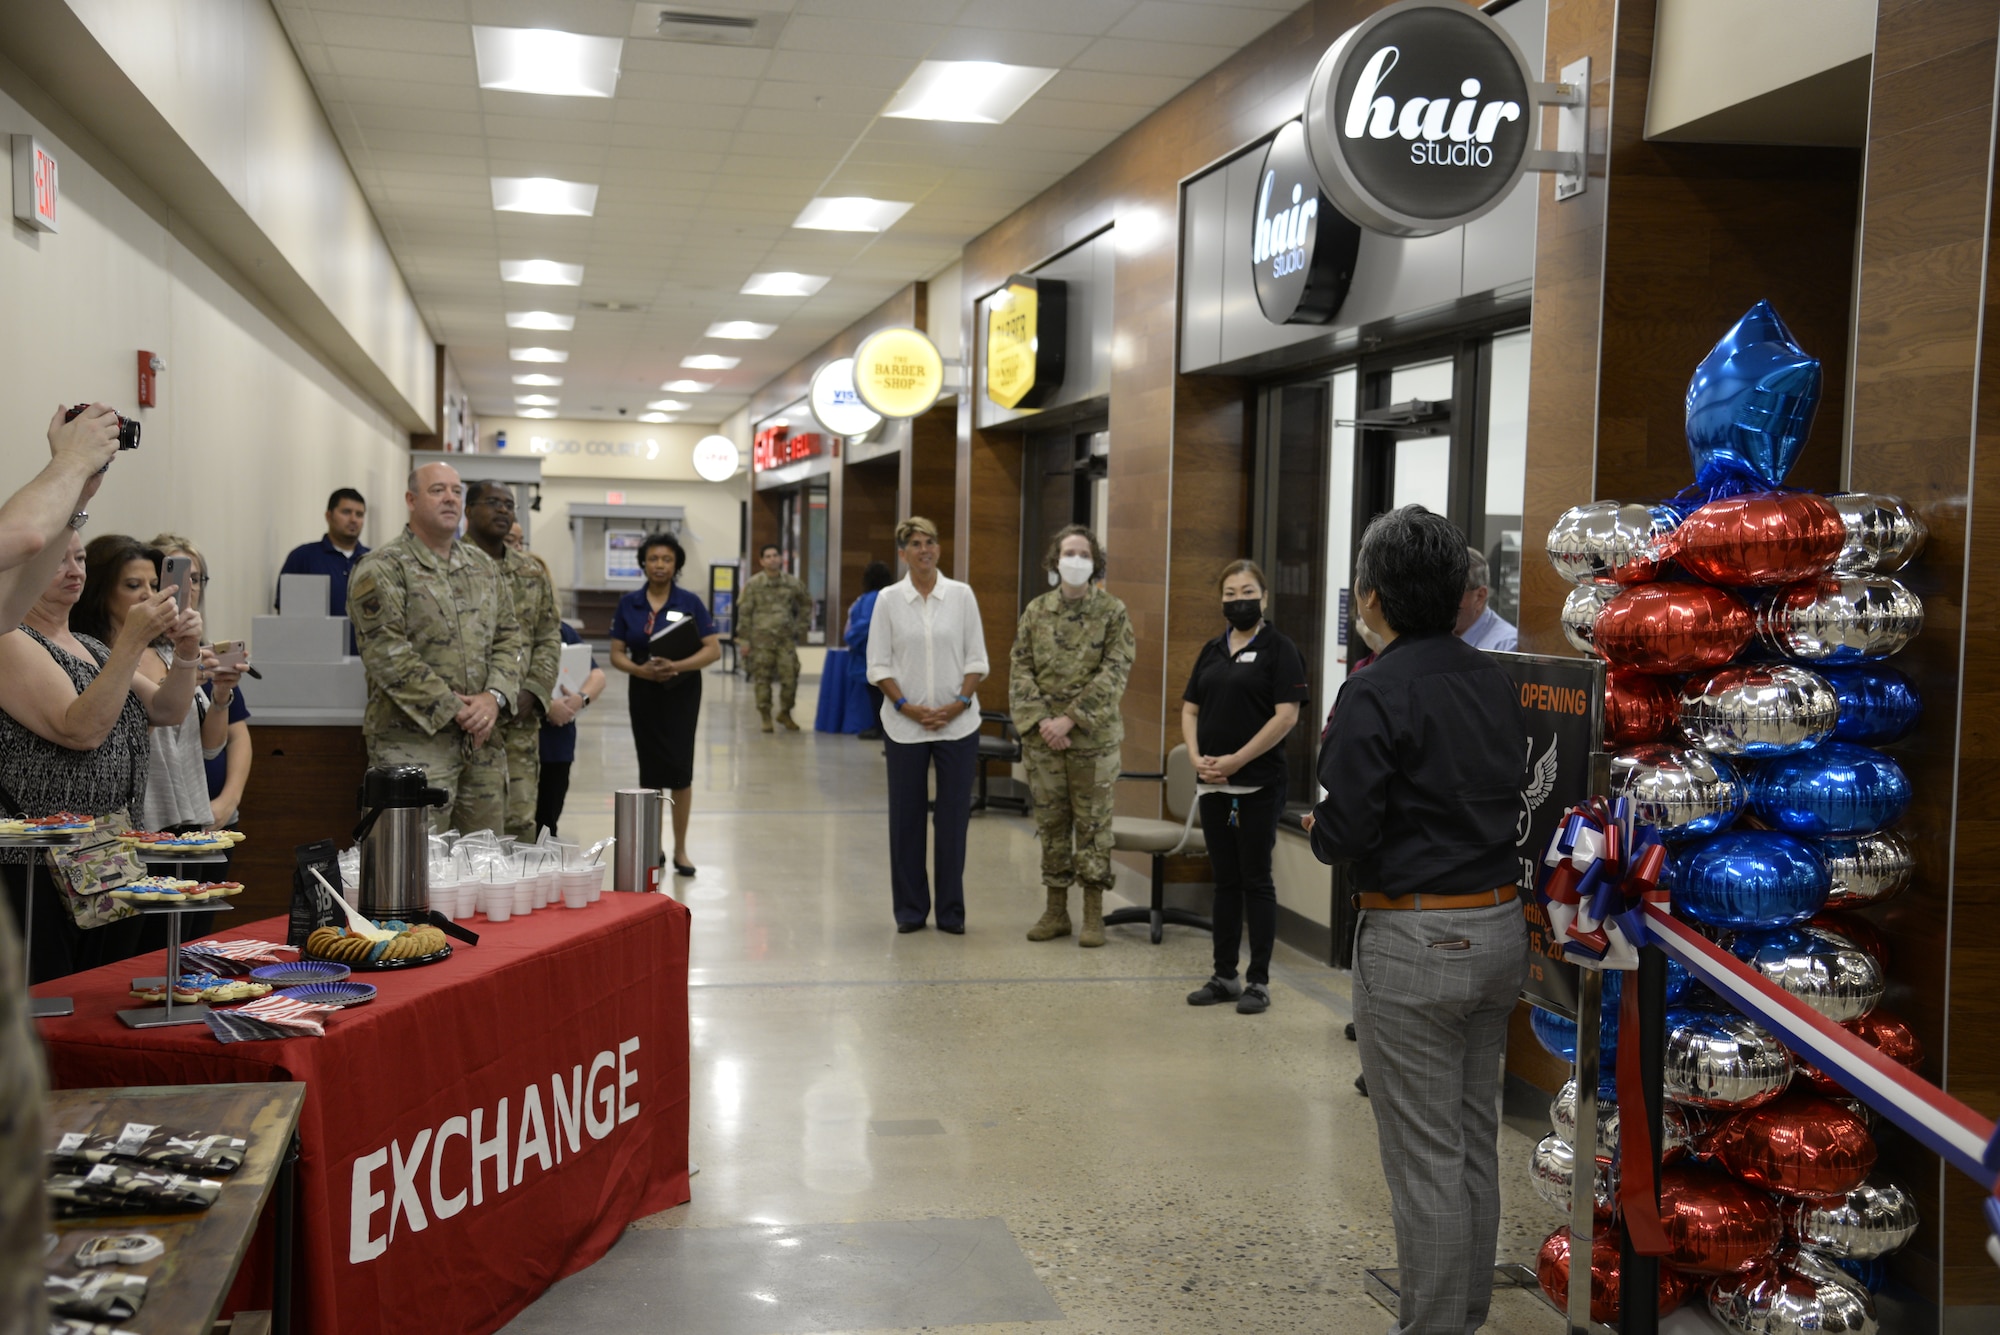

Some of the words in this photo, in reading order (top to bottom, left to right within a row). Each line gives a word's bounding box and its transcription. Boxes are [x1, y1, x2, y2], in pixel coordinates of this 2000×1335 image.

[1345, 46, 1520, 143] hair
[1410, 139, 1493, 167] studio
[37, 150, 56, 222] EXIT
[1253, 169, 1318, 264] hair
[1273, 246, 1305, 278] studio
[875, 363, 925, 377] BARBER
[884, 378, 916, 390] SHOP
[530, 436, 580, 455] FOOD
[585, 440, 643, 457] COURT
[1521, 682, 1587, 716] OPENING
[350, 1036, 640, 1264] EXCHANGE
